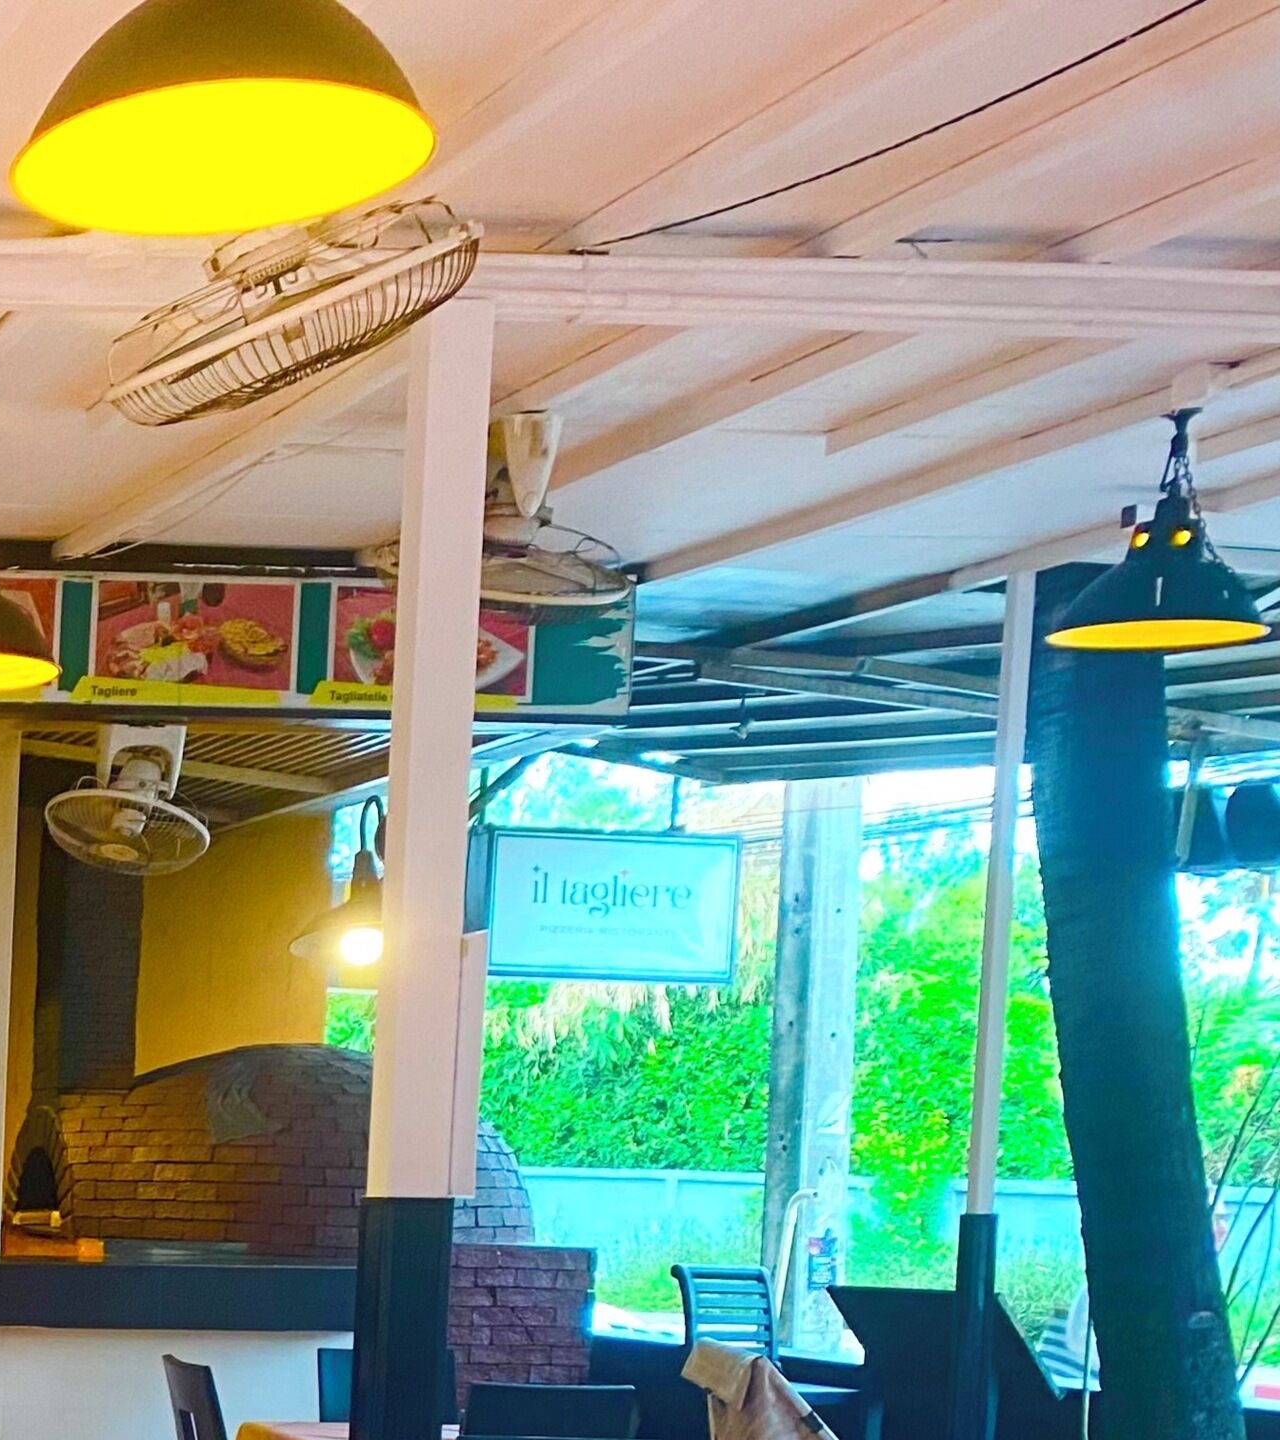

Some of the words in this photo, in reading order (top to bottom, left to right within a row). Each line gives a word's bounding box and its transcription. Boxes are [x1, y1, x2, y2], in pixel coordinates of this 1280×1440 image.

[91, 684, 137, 698] Tagliere
[532, 864, 549, 904] il
[560, 869, 692, 919] tagliere
